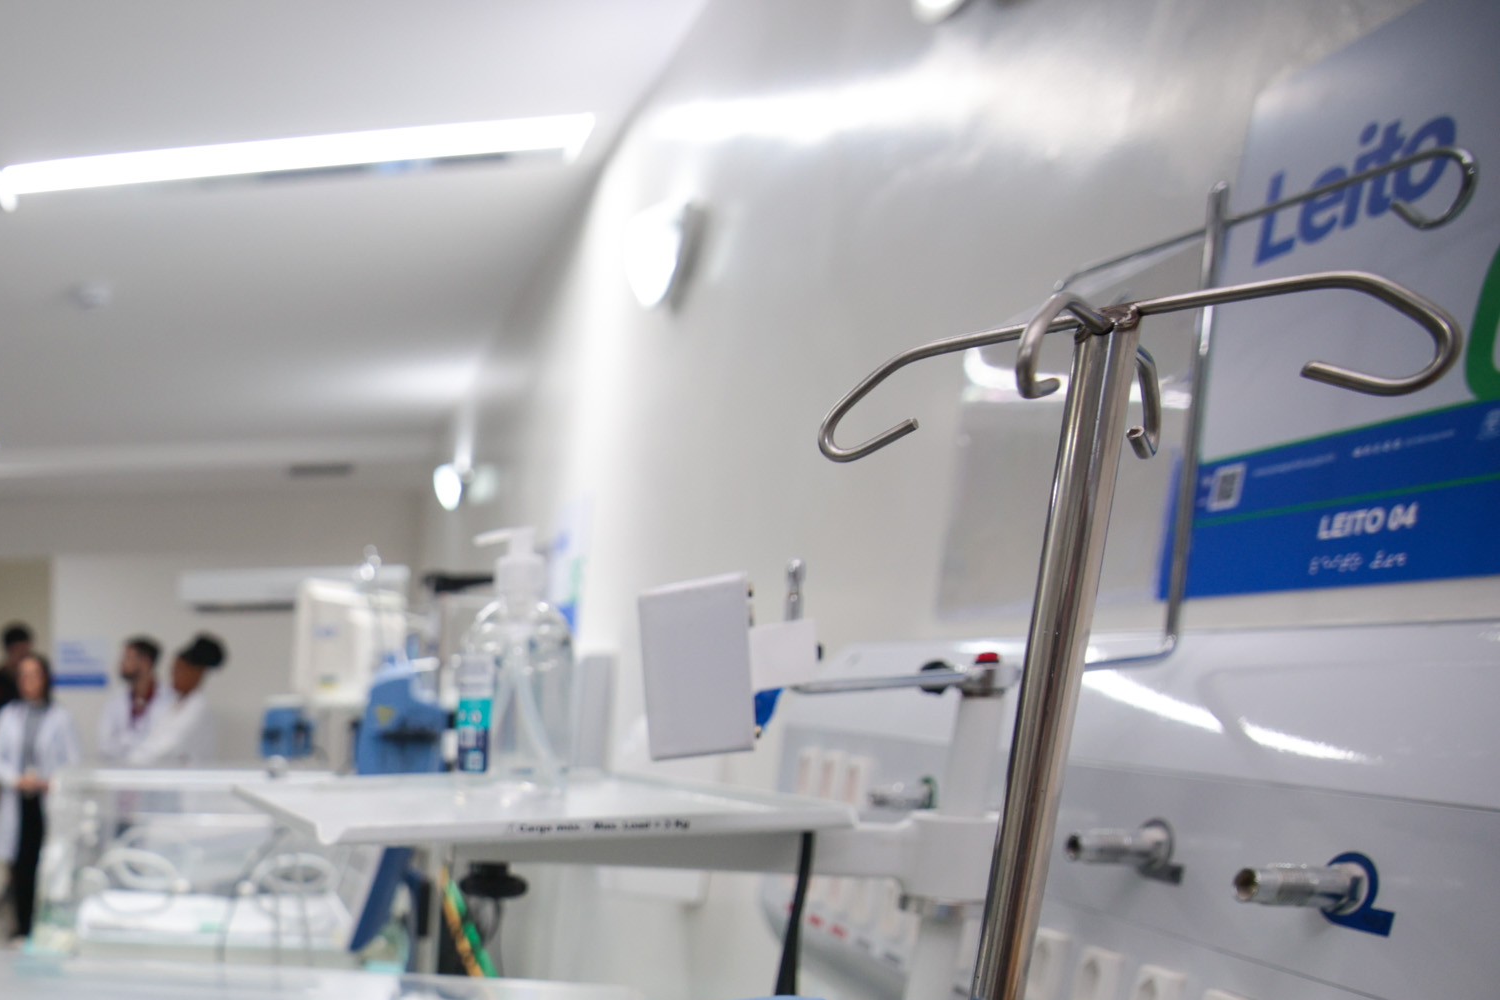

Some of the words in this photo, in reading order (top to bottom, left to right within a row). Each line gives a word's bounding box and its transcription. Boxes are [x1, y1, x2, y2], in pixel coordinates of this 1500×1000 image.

[1254, 115, 1456, 268] Leito
[1317, 506, 1386, 540] LEITO
[1387, 501, 1419, 531] 04
